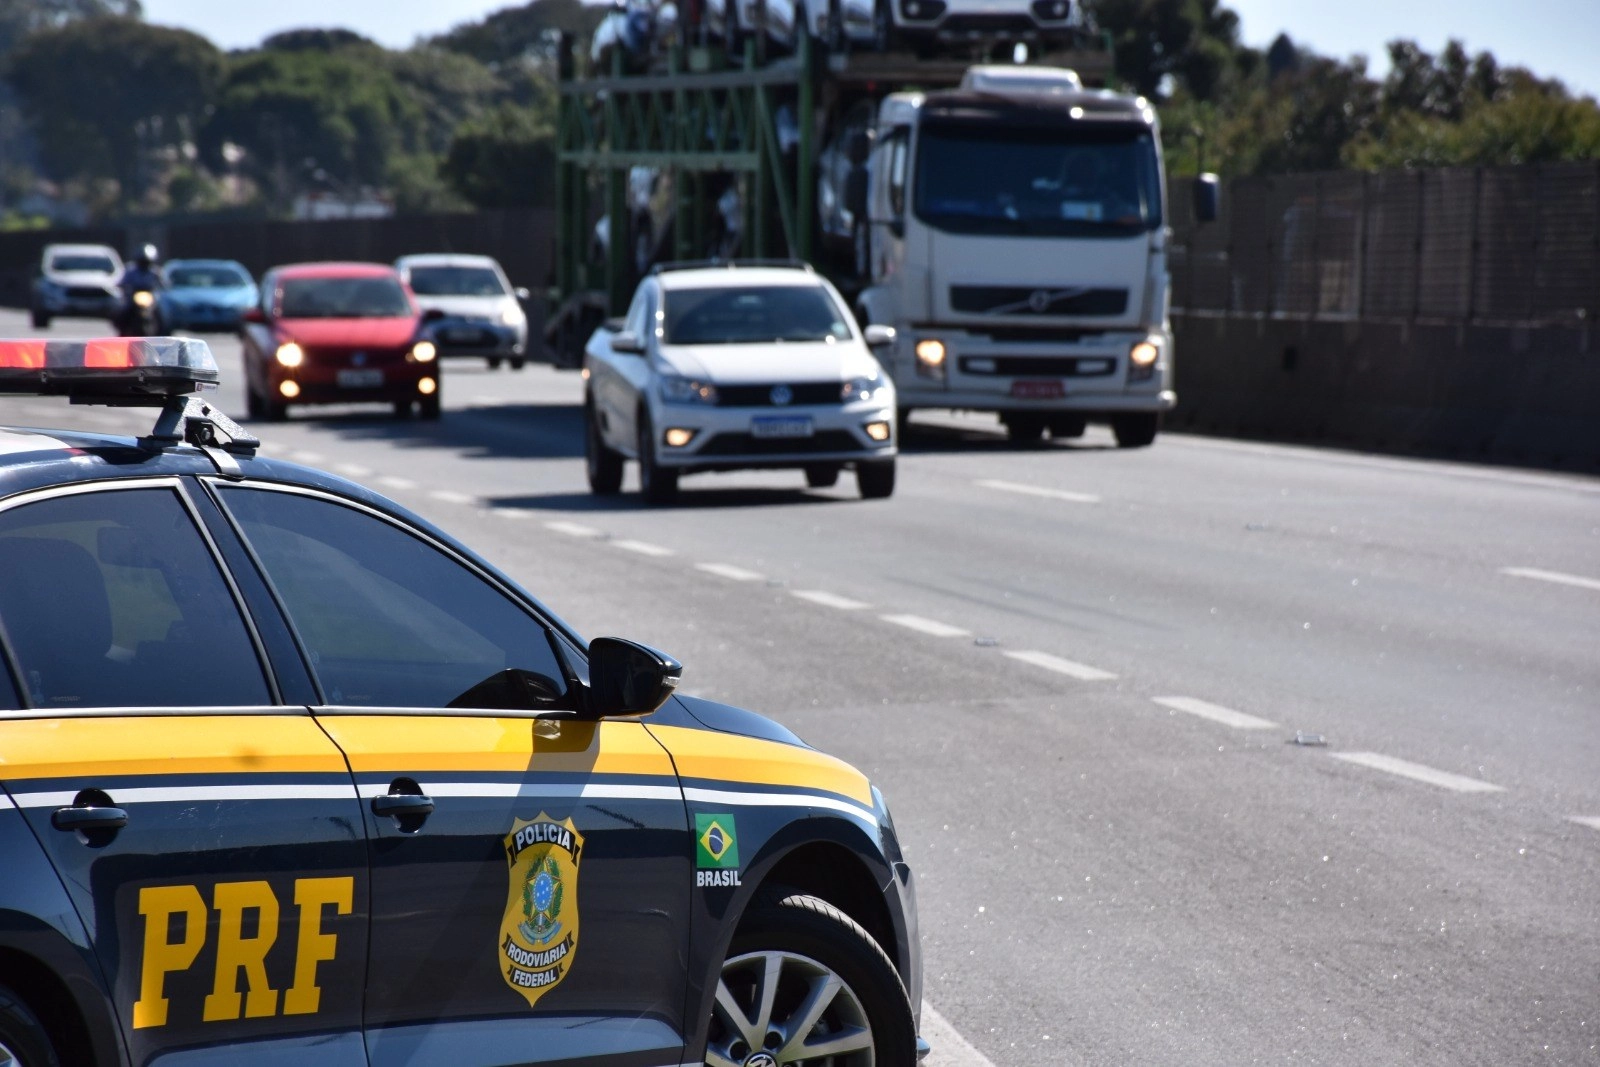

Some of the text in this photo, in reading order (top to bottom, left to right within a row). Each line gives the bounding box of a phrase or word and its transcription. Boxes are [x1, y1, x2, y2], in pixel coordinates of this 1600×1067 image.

[696, 870, 742, 887] BRASIL
[132, 876, 354, 1030] PRF
[513, 969, 556, 987] FEDERAL
